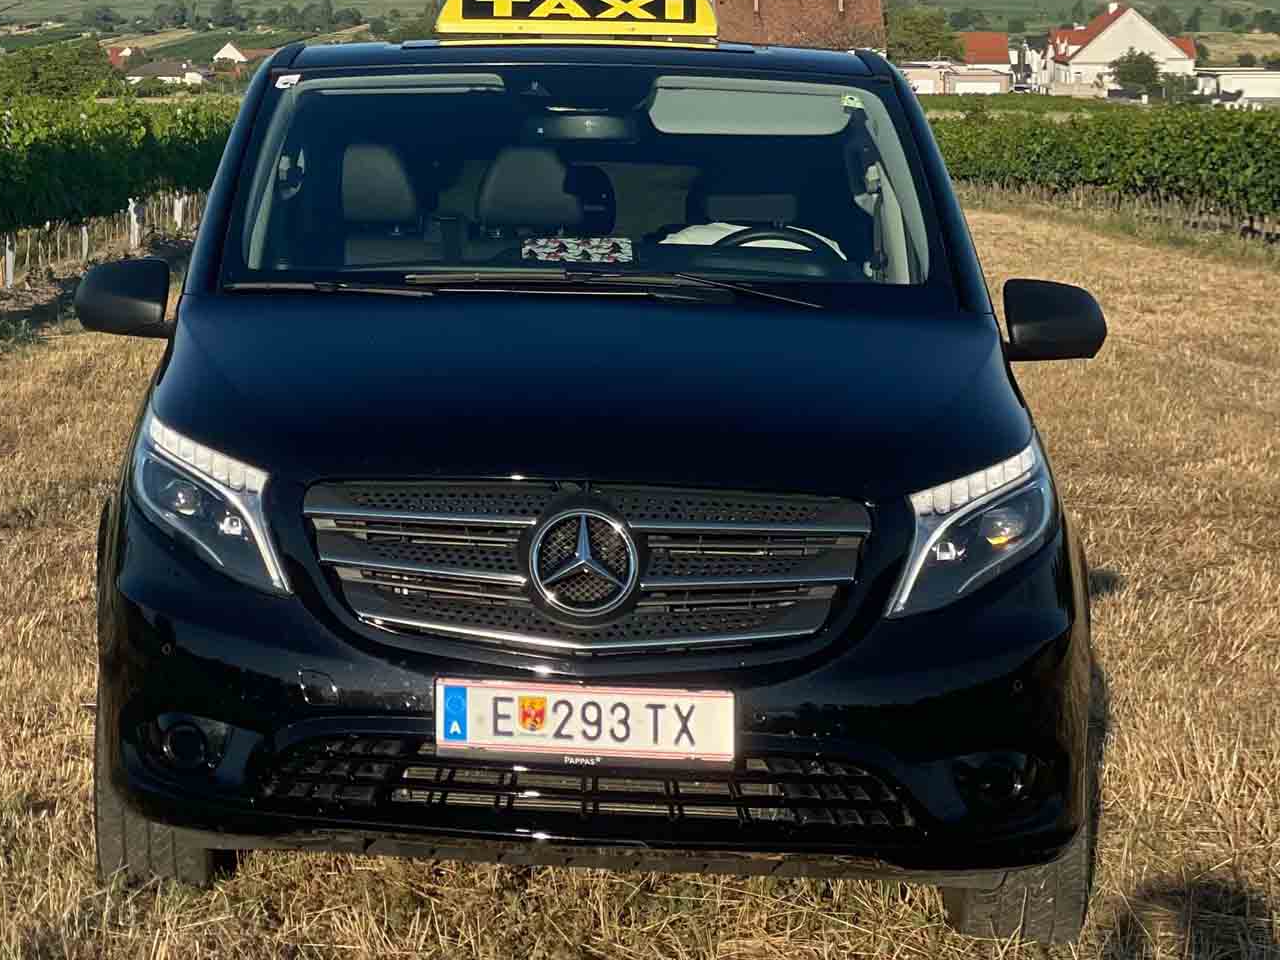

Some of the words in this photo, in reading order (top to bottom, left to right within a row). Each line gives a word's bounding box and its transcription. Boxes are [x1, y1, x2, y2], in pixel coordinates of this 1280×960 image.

[449, 720, 462, 735] A
[492, 696, 515, 737] E
[552, 699, 631, 742] 293
[645, 703, 696, 746] TX
